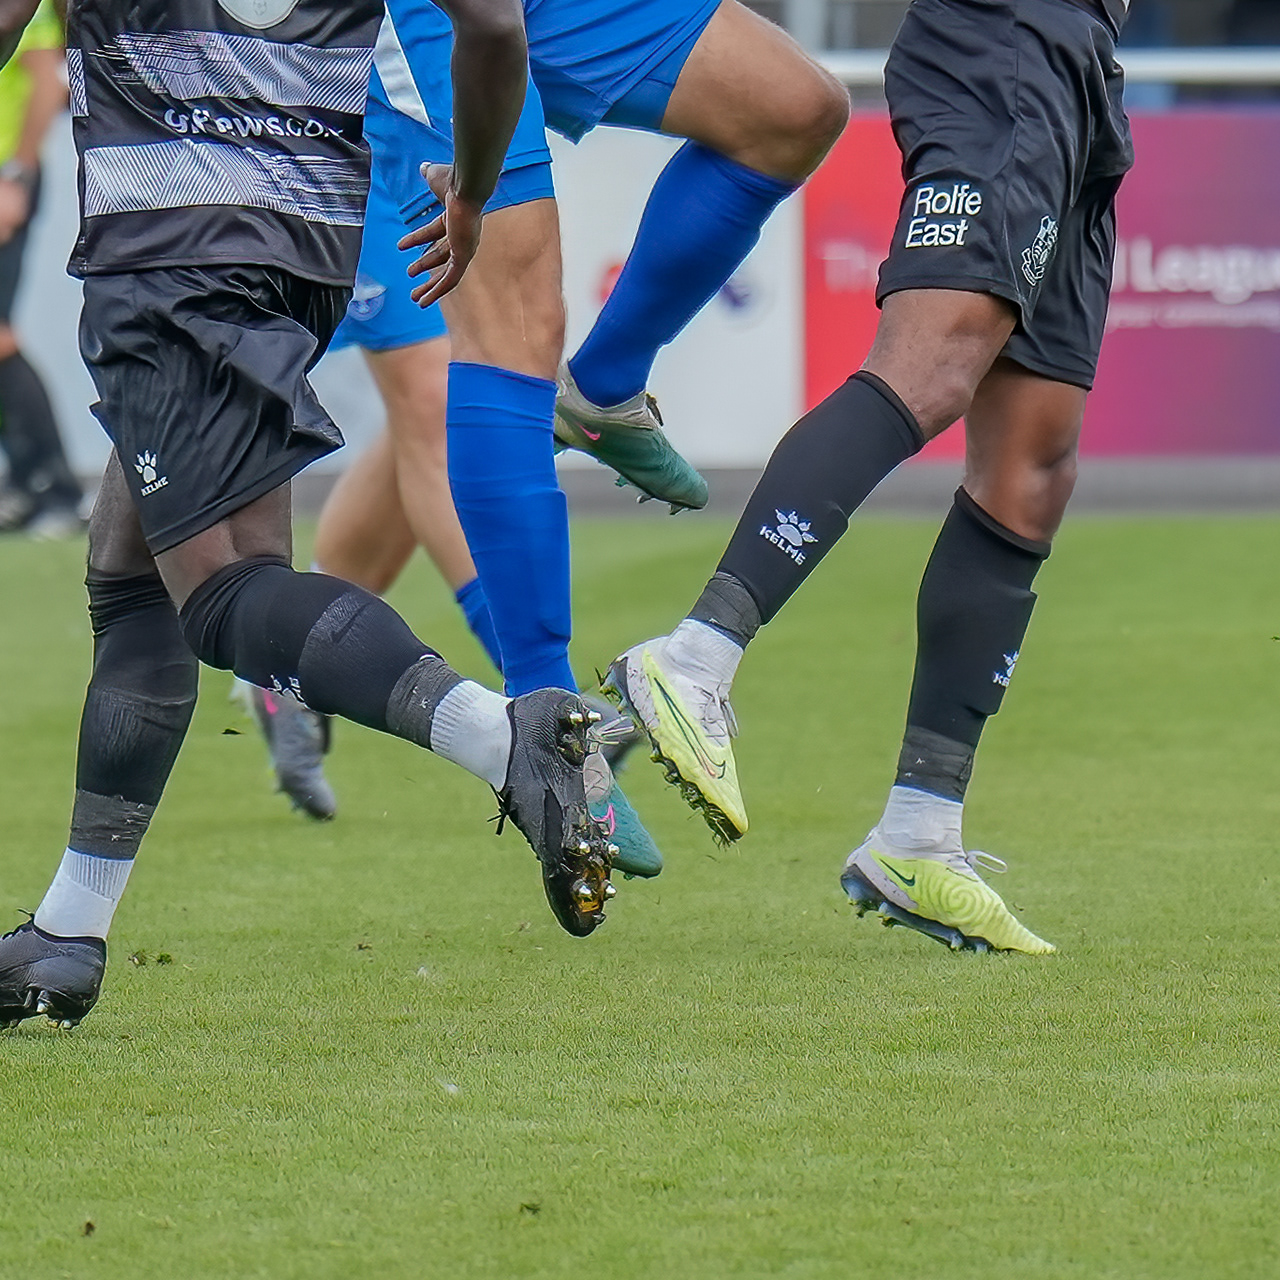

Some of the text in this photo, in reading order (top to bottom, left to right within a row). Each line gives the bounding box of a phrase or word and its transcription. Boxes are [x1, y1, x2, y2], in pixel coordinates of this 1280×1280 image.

[913, 183, 982, 216] Rolfe
[905, 217, 968, 248] East
[759, 526, 806, 566] KELME
